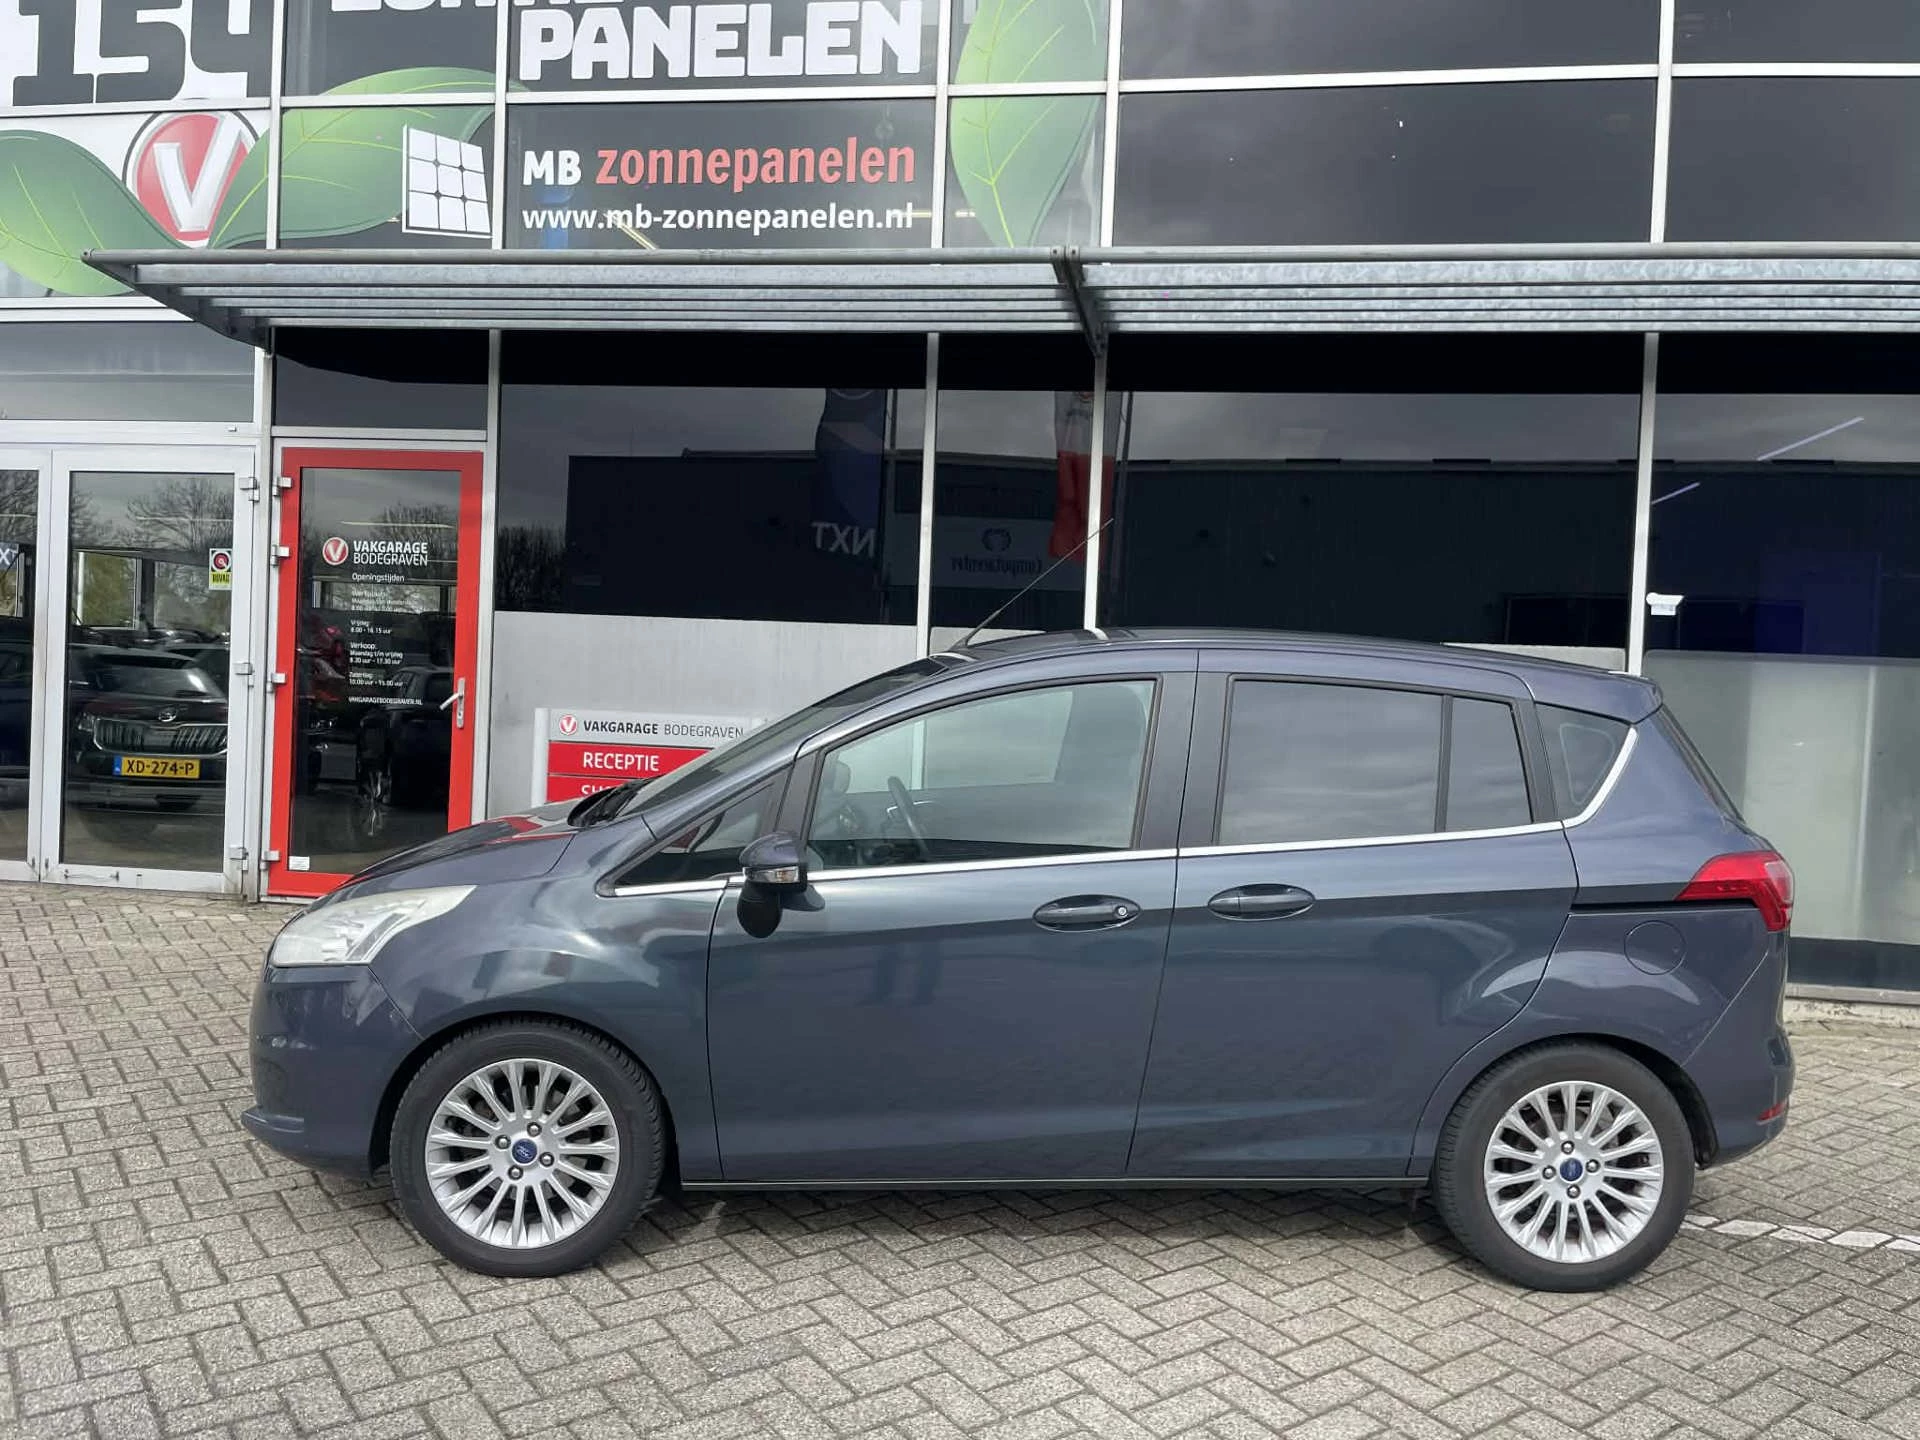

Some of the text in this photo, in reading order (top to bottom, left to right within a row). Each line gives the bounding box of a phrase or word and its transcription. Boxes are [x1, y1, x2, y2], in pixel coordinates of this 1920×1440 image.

[519, 1, 922, 81] PANELEN
[522, 137, 916, 193] MB zonnepanelen
[522, 202, 914, 236] www.mb-zonnepanelen.nl
[353, 540, 428, 554] VAKGARAGE
[353, 552, 428, 566] BODEGRAVEN
[352, 572, 405, 583] Openingstijden
[583, 720, 659, 735] VAKGARAGE
[664, 723, 744, 738] BODEGRAVEN
[127, 759, 194, 776] XD-274-P
[583, 751, 660, 772] RECEPTIE
